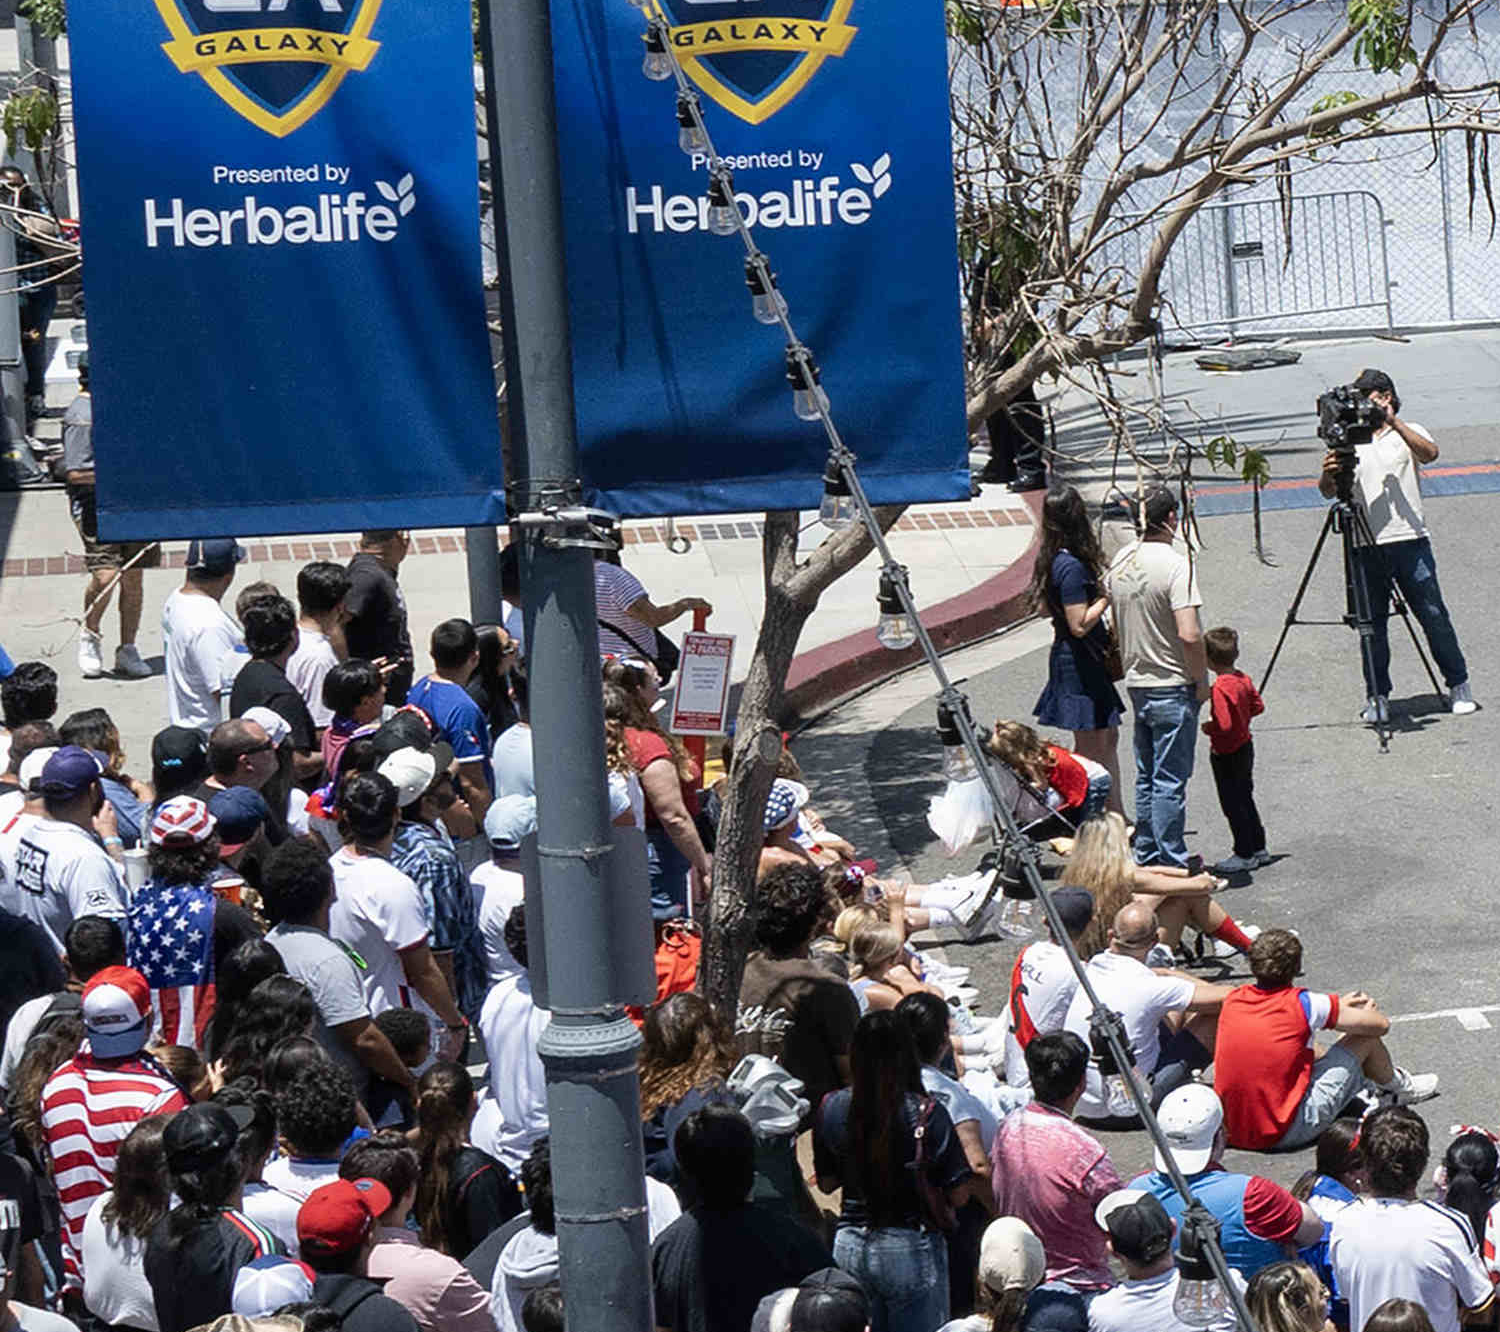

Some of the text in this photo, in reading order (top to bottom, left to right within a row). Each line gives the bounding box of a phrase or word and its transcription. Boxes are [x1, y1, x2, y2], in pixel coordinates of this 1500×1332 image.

[196, 33, 352, 57] GALAXY
[673, 22, 829, 47] GALAXY
[691, 151, 824, 171] Presented by
[213, 163, 351, 185] Presented by
[145, 192, 398, 248] Herbalife
